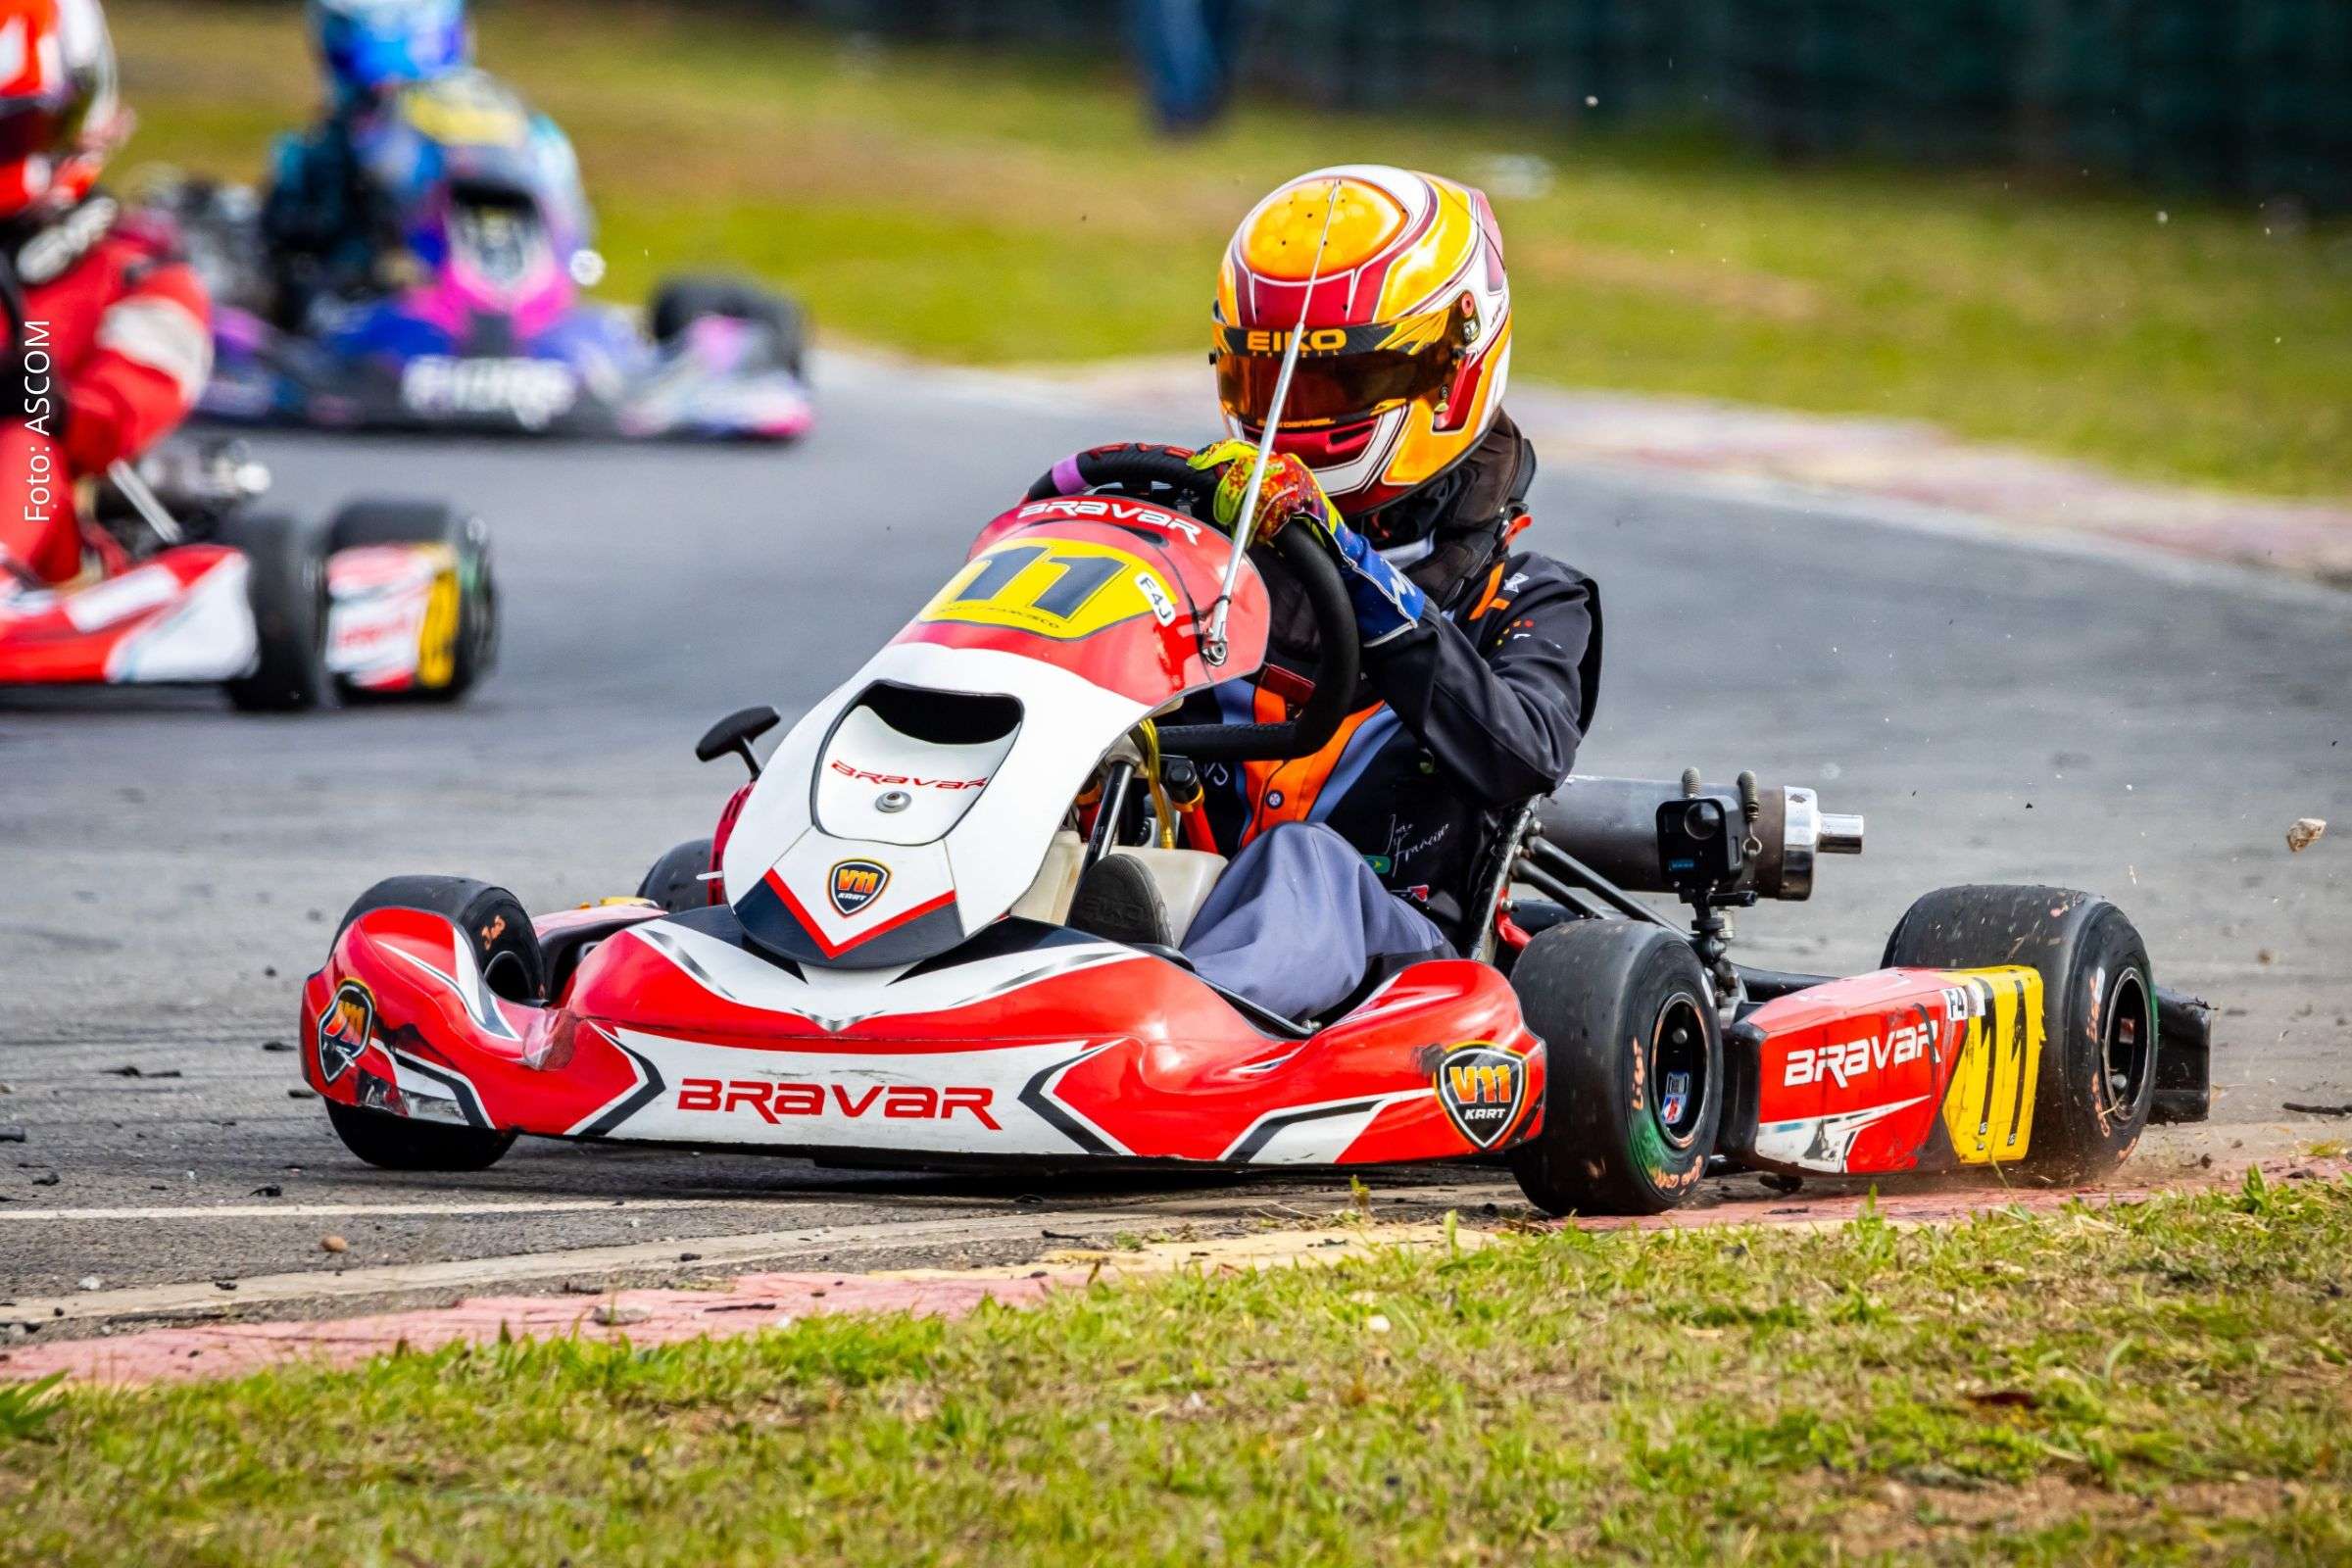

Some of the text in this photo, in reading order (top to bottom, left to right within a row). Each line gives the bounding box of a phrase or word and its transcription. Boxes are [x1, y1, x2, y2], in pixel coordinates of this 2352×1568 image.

[1247, 328, 1348, 352] EIKO
[956, 545, 1128, 620] 11
[1464, 1107, 1507, 1121] KART
